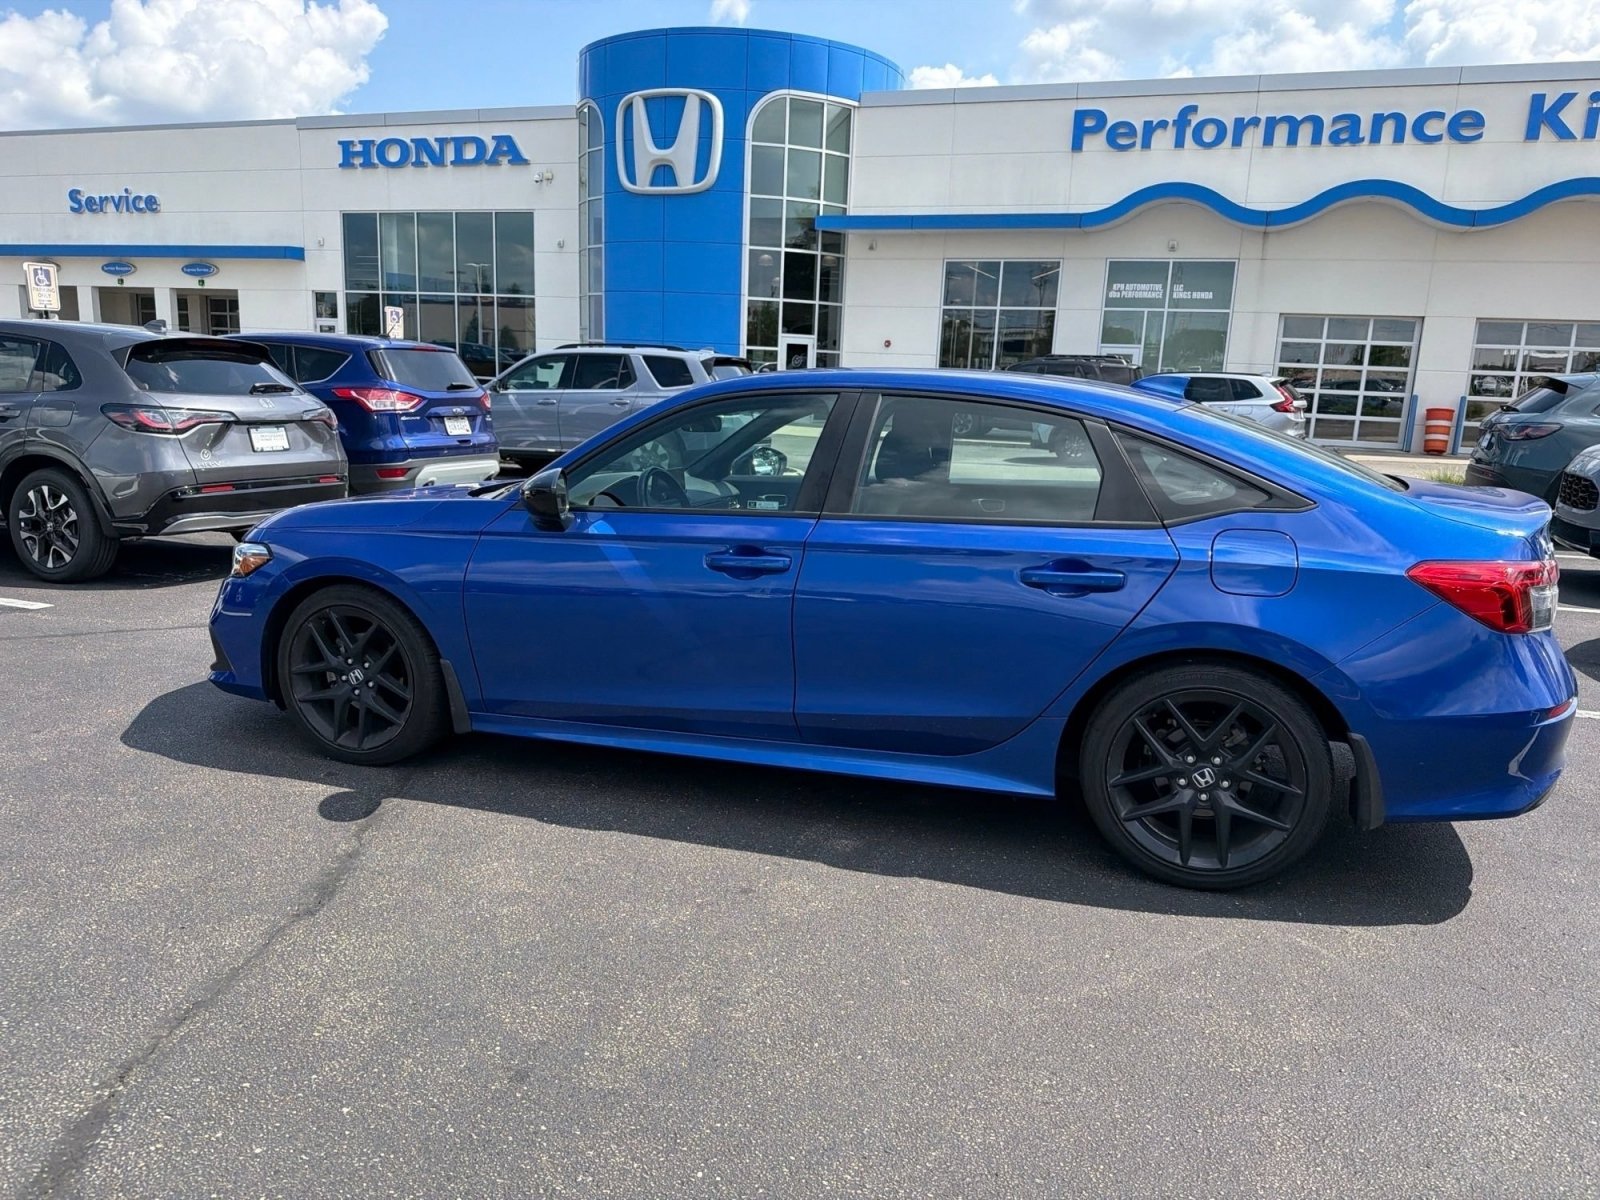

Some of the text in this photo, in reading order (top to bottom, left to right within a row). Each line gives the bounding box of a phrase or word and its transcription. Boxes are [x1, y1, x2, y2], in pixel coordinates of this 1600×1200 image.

[1071, 91, 1600, 152] Performance Ki
[338, 134, 530, 169] HONDA
[68, 188, 160, 213] Service
[1120, 291, 1163, 299] PERFORMANCE
[1172, 291, 1191, 299] KINGS
[1191, 291, 1213, 299] HONDA
